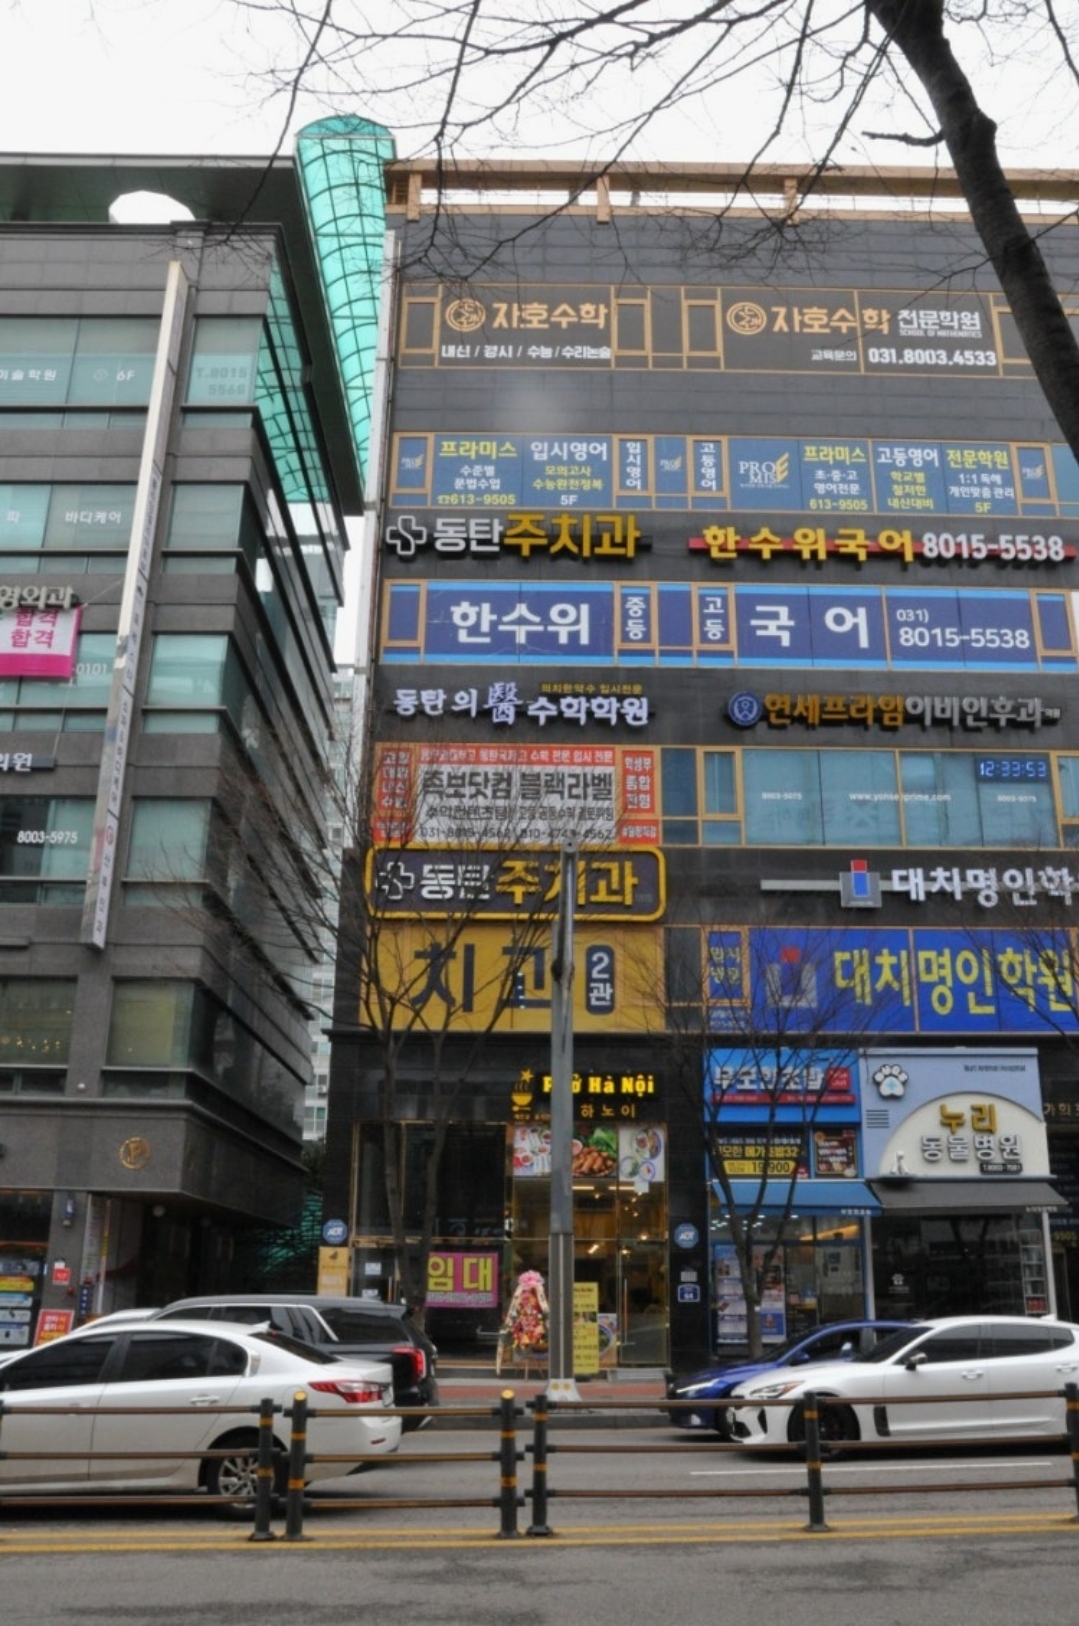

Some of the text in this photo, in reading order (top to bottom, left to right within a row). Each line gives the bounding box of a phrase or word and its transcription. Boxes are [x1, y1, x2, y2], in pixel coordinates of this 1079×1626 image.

[492, 302, 608, 329] 자호수학
[770, 305, 981, 335] 자호수학 전문학원
[441, 345, 470, 358] 내신
[562, 346, 611, 360] 수리논술
[811, 348, 996, 366] 교육문의 031.8003.4533
[439, 441, 607, 461] 프라미스 입시영어
[803, 445, 1009, 470] 프라미스 고등영어 전문학원
[626, 441, 641, 491] 입시영어
[700, 442, 716, 491] 고등영어
[452, 494, 578, 506] 613-9505 5F
[809, 499, 868, 511] 613-9505
[974, 502, 992, 514] 5F
[65, 511, 122, 524] 바디케어
[433, 514, 641, 558] 동탄주치과
[922, 533, 1065, 562] 8015-5538
[451, 602, 590, 645] 한수위
[625, 596, 646, 641] 중등
[703, 596, 725, 640] 고등
[896, 609, 929, 623] 031)
[11, 628, 54, 648] 합격
[899, 627, 1031, 649] 8015-5538
[393, 688, 446, 717] 동탄
[451, 688, 478, 718] 의
[527, 696, 649, 727] 수학학원
[764, 693, 1042, 728] 연세프라임이비인후과
[979, 760, 1047, 777] 12:33:53
[520, 772, 613, 801] 블랙라벨
[849, 791, 951, 801] www.yonseprime.com
[17, 831, 78, 844] 8003-5975
[891, 866, 1079, 908] 대치명인학
[588, 952, 613, 1006] 2관
[834, 947, 1074, 1016] 대치명인학원
[589, 1075, 615, 1094] Hà
[621, 1074, 654, 1097] Nội
[940, 1103, 998, 1135] 누리
[752, 1161, 790, 1174] 19900
[427, 1255, 493, 1291] 임대
